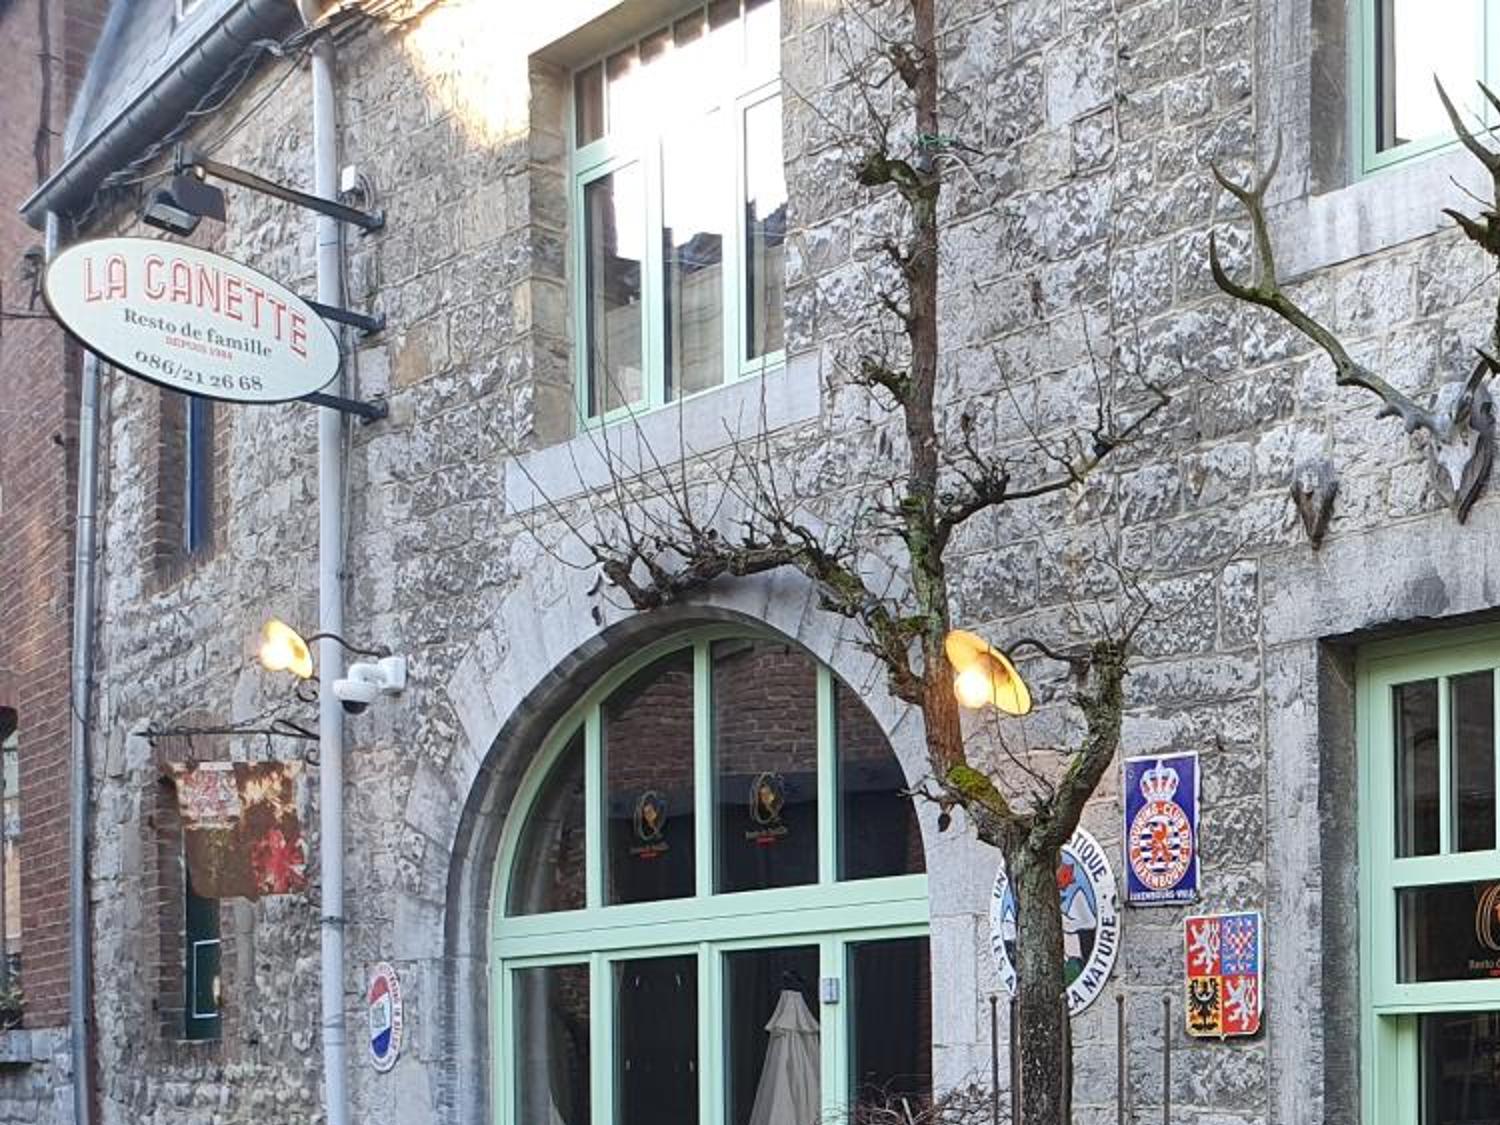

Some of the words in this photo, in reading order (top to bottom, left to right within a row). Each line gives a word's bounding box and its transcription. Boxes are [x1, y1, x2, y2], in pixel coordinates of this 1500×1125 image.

[83, 254, 128, 303] LA
[143, 254, 307, 359] CANETTE
[124, 308, 177, 334] Resto
[181, 322, 203, 340] de
[207, 327, 272, 356] famille
[135, 350, 203, 385] 086/21
[209, 374, 234, 391] 26
[239, 375, 263, 392] 68
[1082, 915, 1116, 994] NATURE
